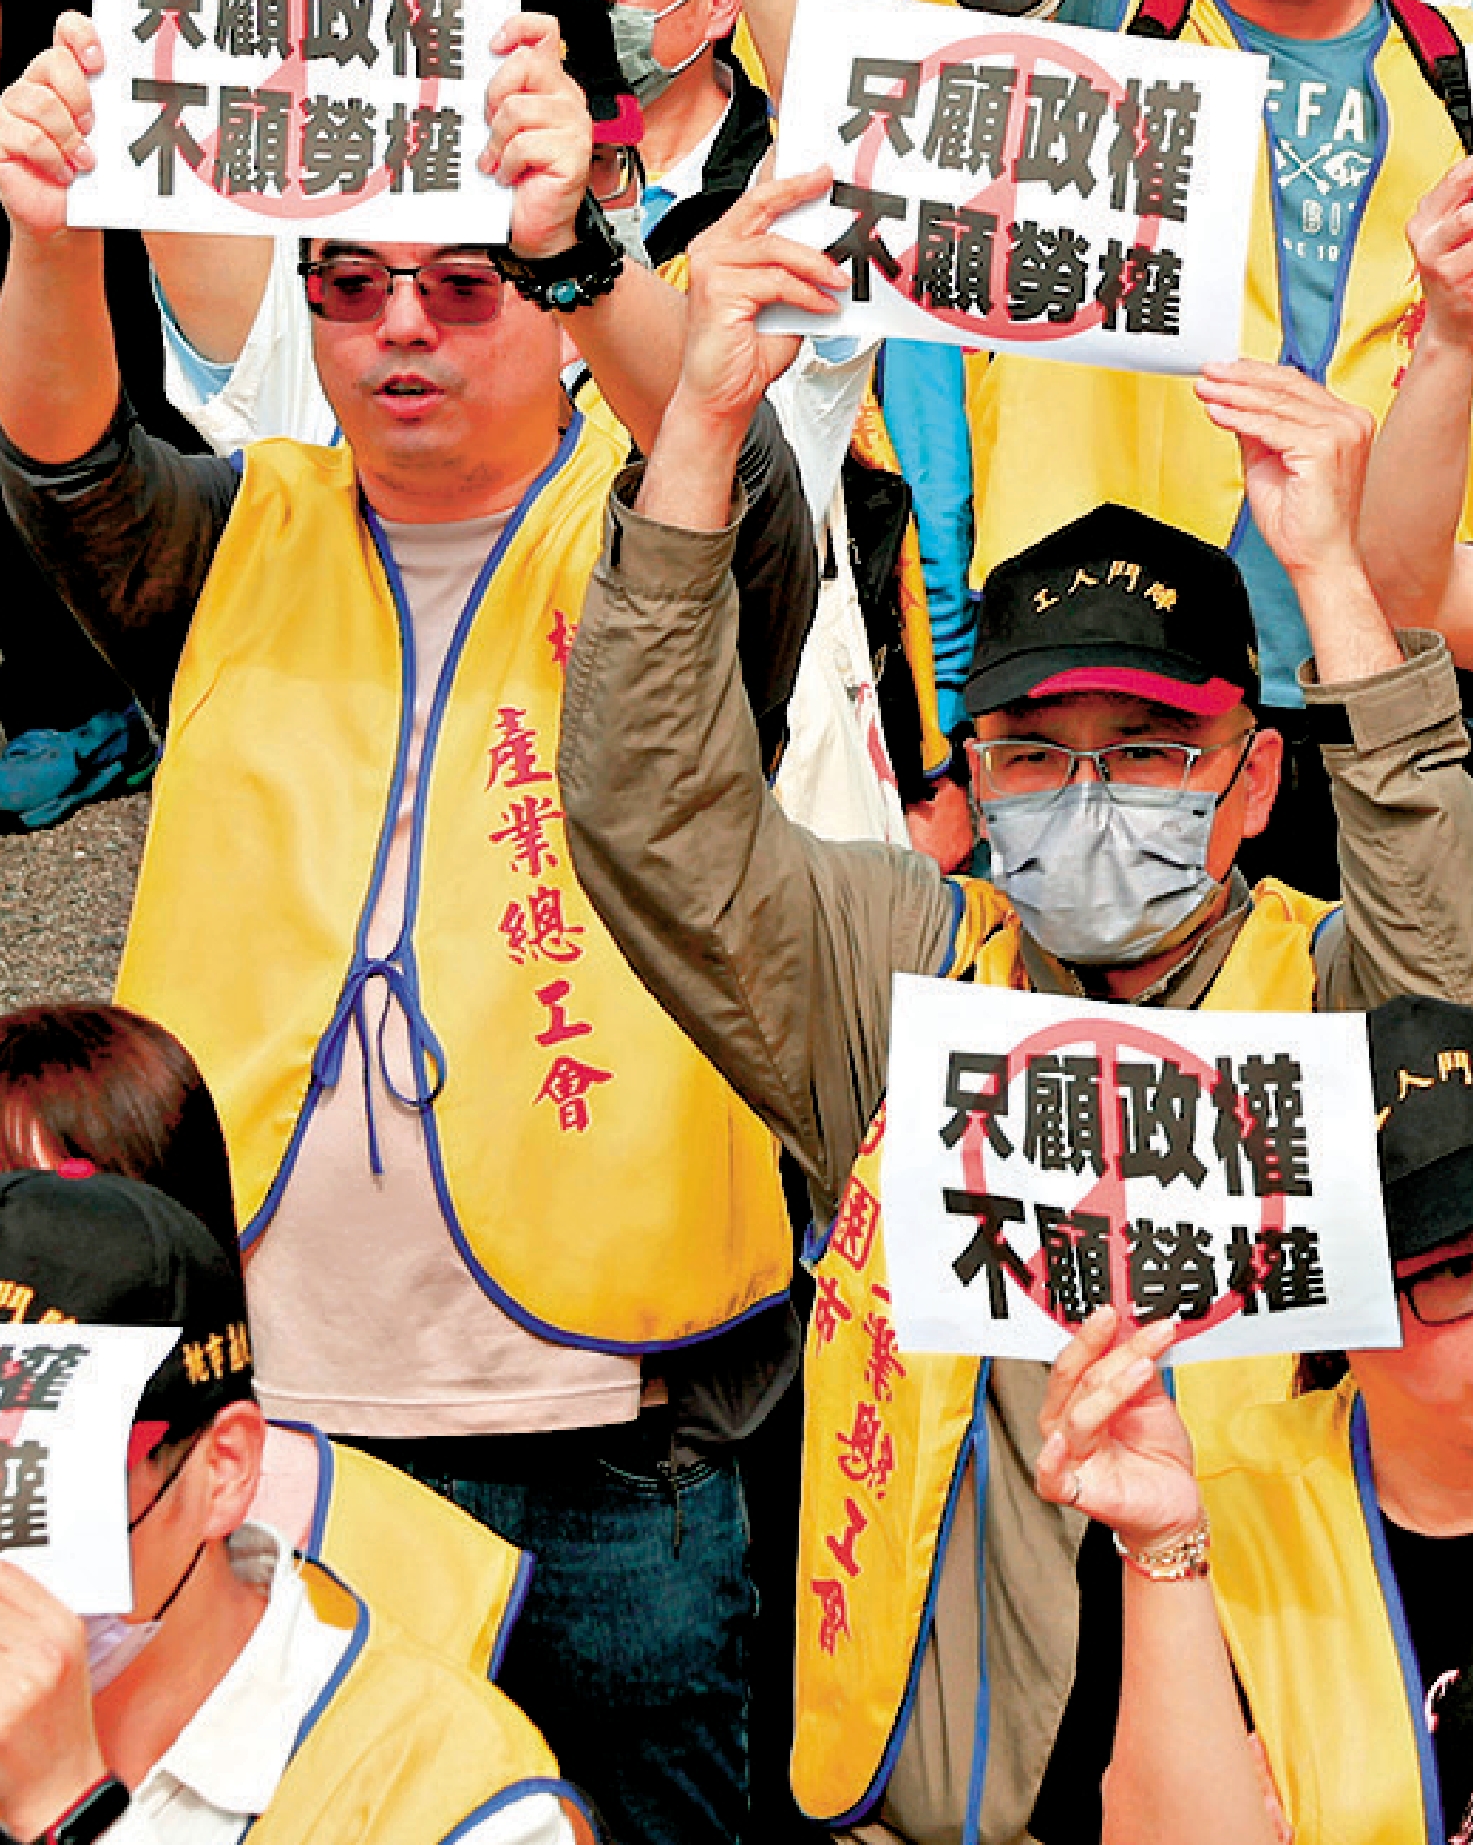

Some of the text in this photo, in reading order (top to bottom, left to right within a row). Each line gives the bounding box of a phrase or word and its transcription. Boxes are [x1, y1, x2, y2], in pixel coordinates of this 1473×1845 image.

[128, 77, 464, 197] 不顧勞權
[837, 56, 1203, 223] 只顧政權
[825, 177, 1183, 338] 不顧勞權
[486, 709, 614, 1131] 產業總工會
[939, 1051, 1312, 1196] 只顧政權
[944, 1188, 1328, 1324] 不顧勞權
